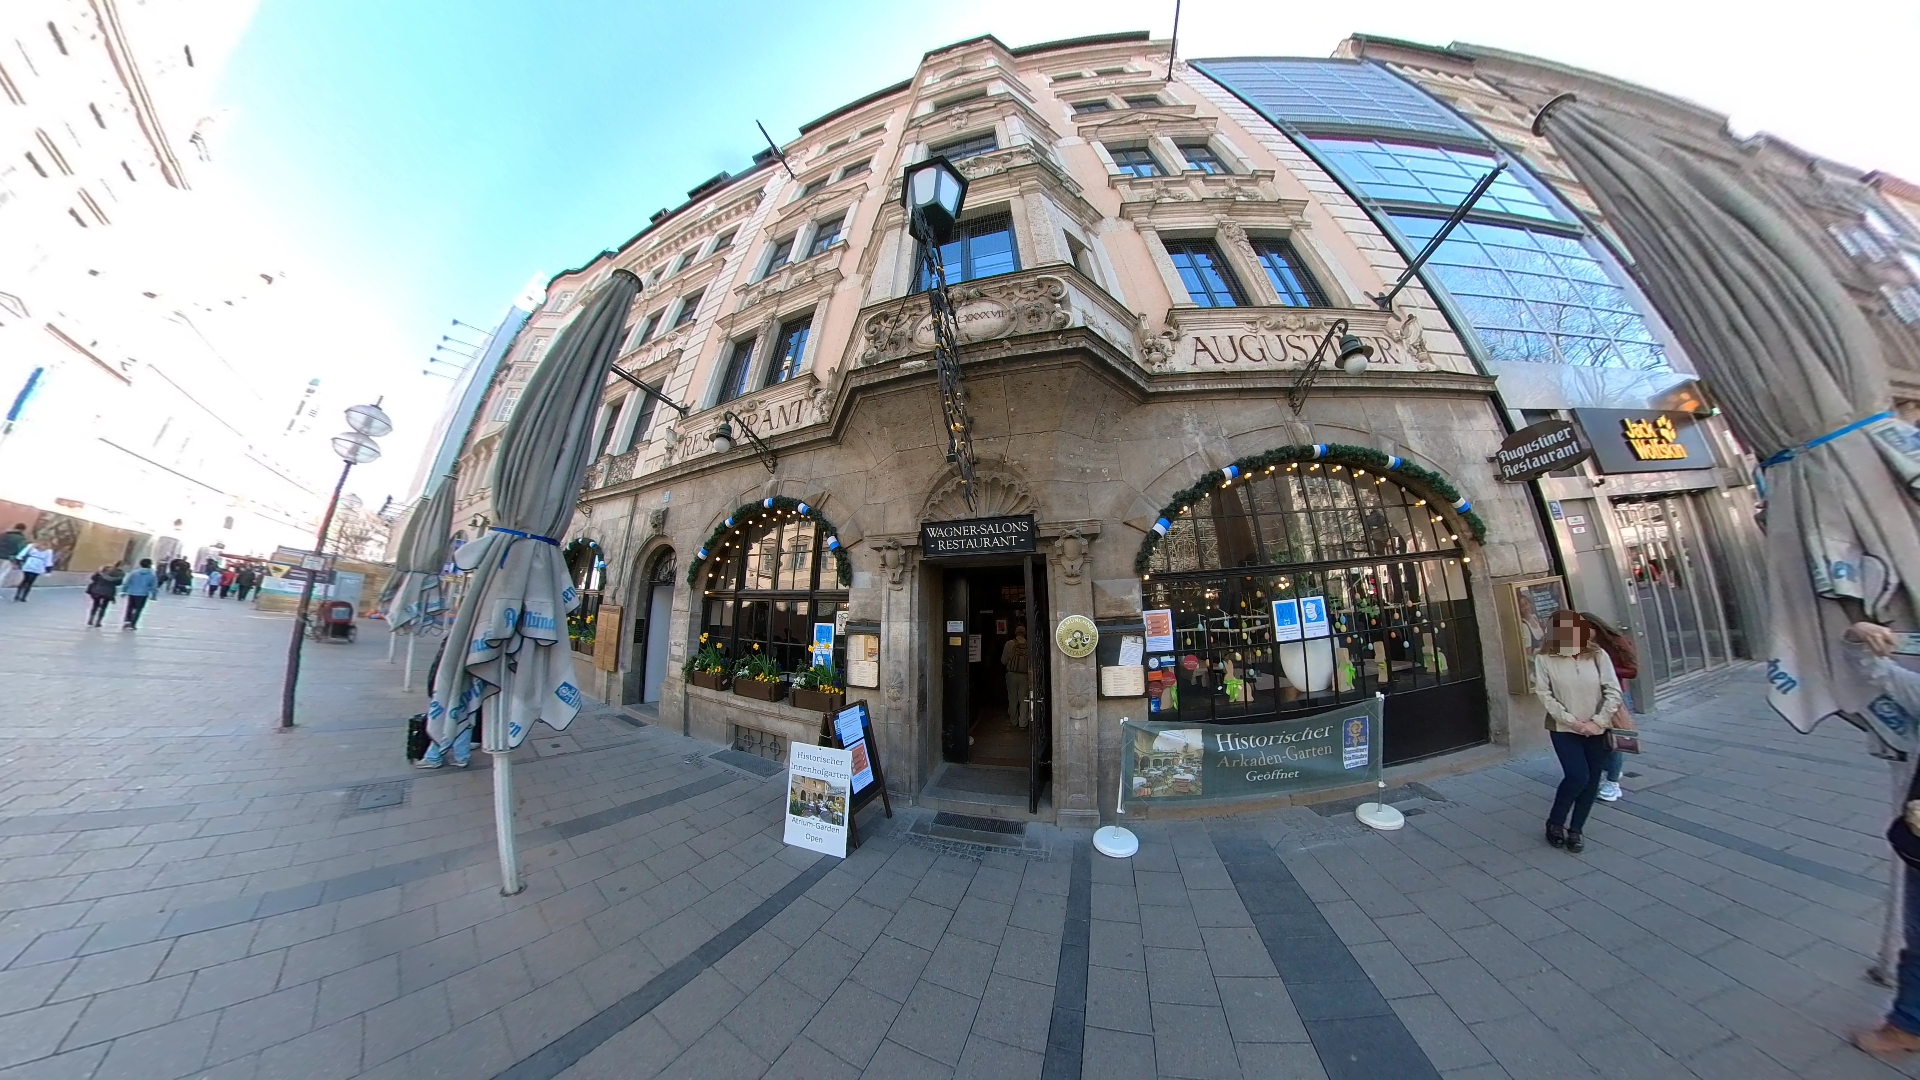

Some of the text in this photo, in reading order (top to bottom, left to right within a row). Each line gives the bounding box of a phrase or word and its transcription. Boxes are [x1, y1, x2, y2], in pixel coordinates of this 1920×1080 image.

[1624, 417, 1657, 438] Jack
[1499, 426, 1572, 464] Augustiner
[1631, 438, 1688, 460] Wolfskin
[1502, 440, 1580, 478] Restaurant
[926, 521, 1029, 538] WAGNER-SALONS
[938, 535, 1018, 551] RESTAURANT
[1215, 725, 1334, 753] Historischer
[797, 751, 844, 766] Historischer
[1216, 744, 1333, 768] Arkaden-Garten
[791, 762, 850, 780] Innenhofgarten
[1246, 769, 1300, 782] Geöffnet
[791, 816, 840, 835] Atrium-Garden
[805, 833, 823, 844] Open
